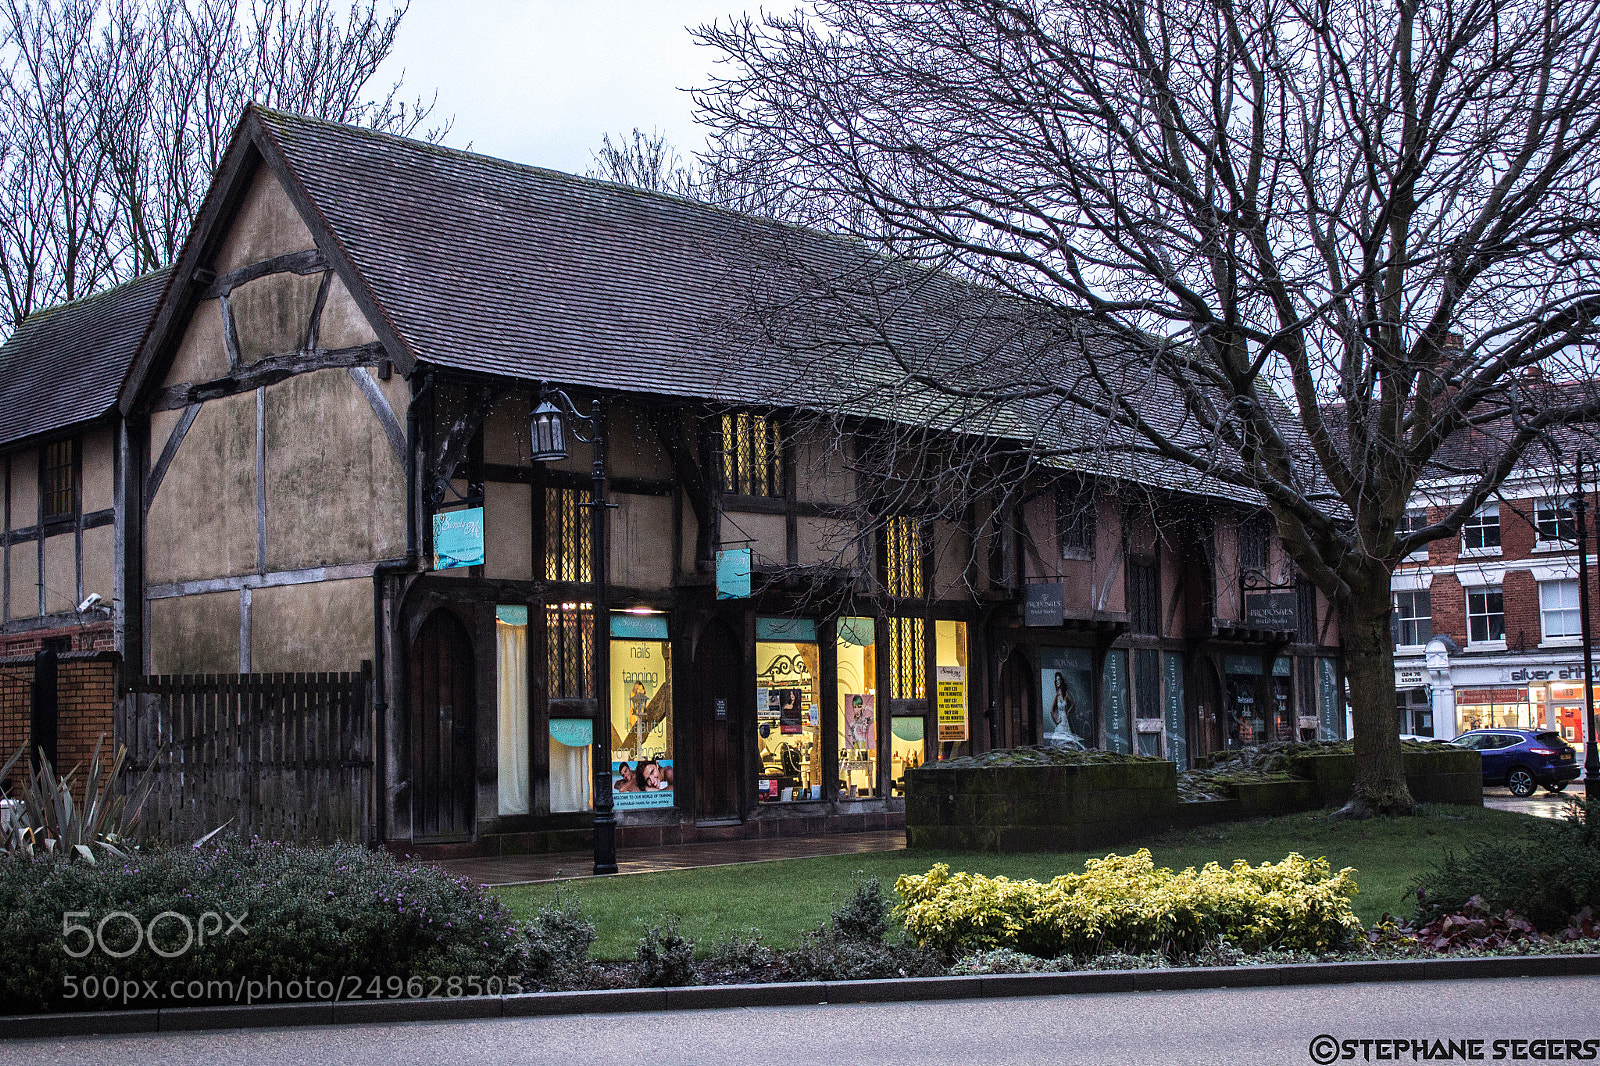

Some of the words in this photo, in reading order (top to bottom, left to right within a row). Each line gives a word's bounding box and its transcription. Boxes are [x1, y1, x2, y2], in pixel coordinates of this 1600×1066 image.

[630, 642, 651, 659] nails
[622, 667, 659, 688] tanning
[1511, 667, 1554, 681] silver
[626, 716, 664, 738] beauty
[616, 743, 637, 760] and
